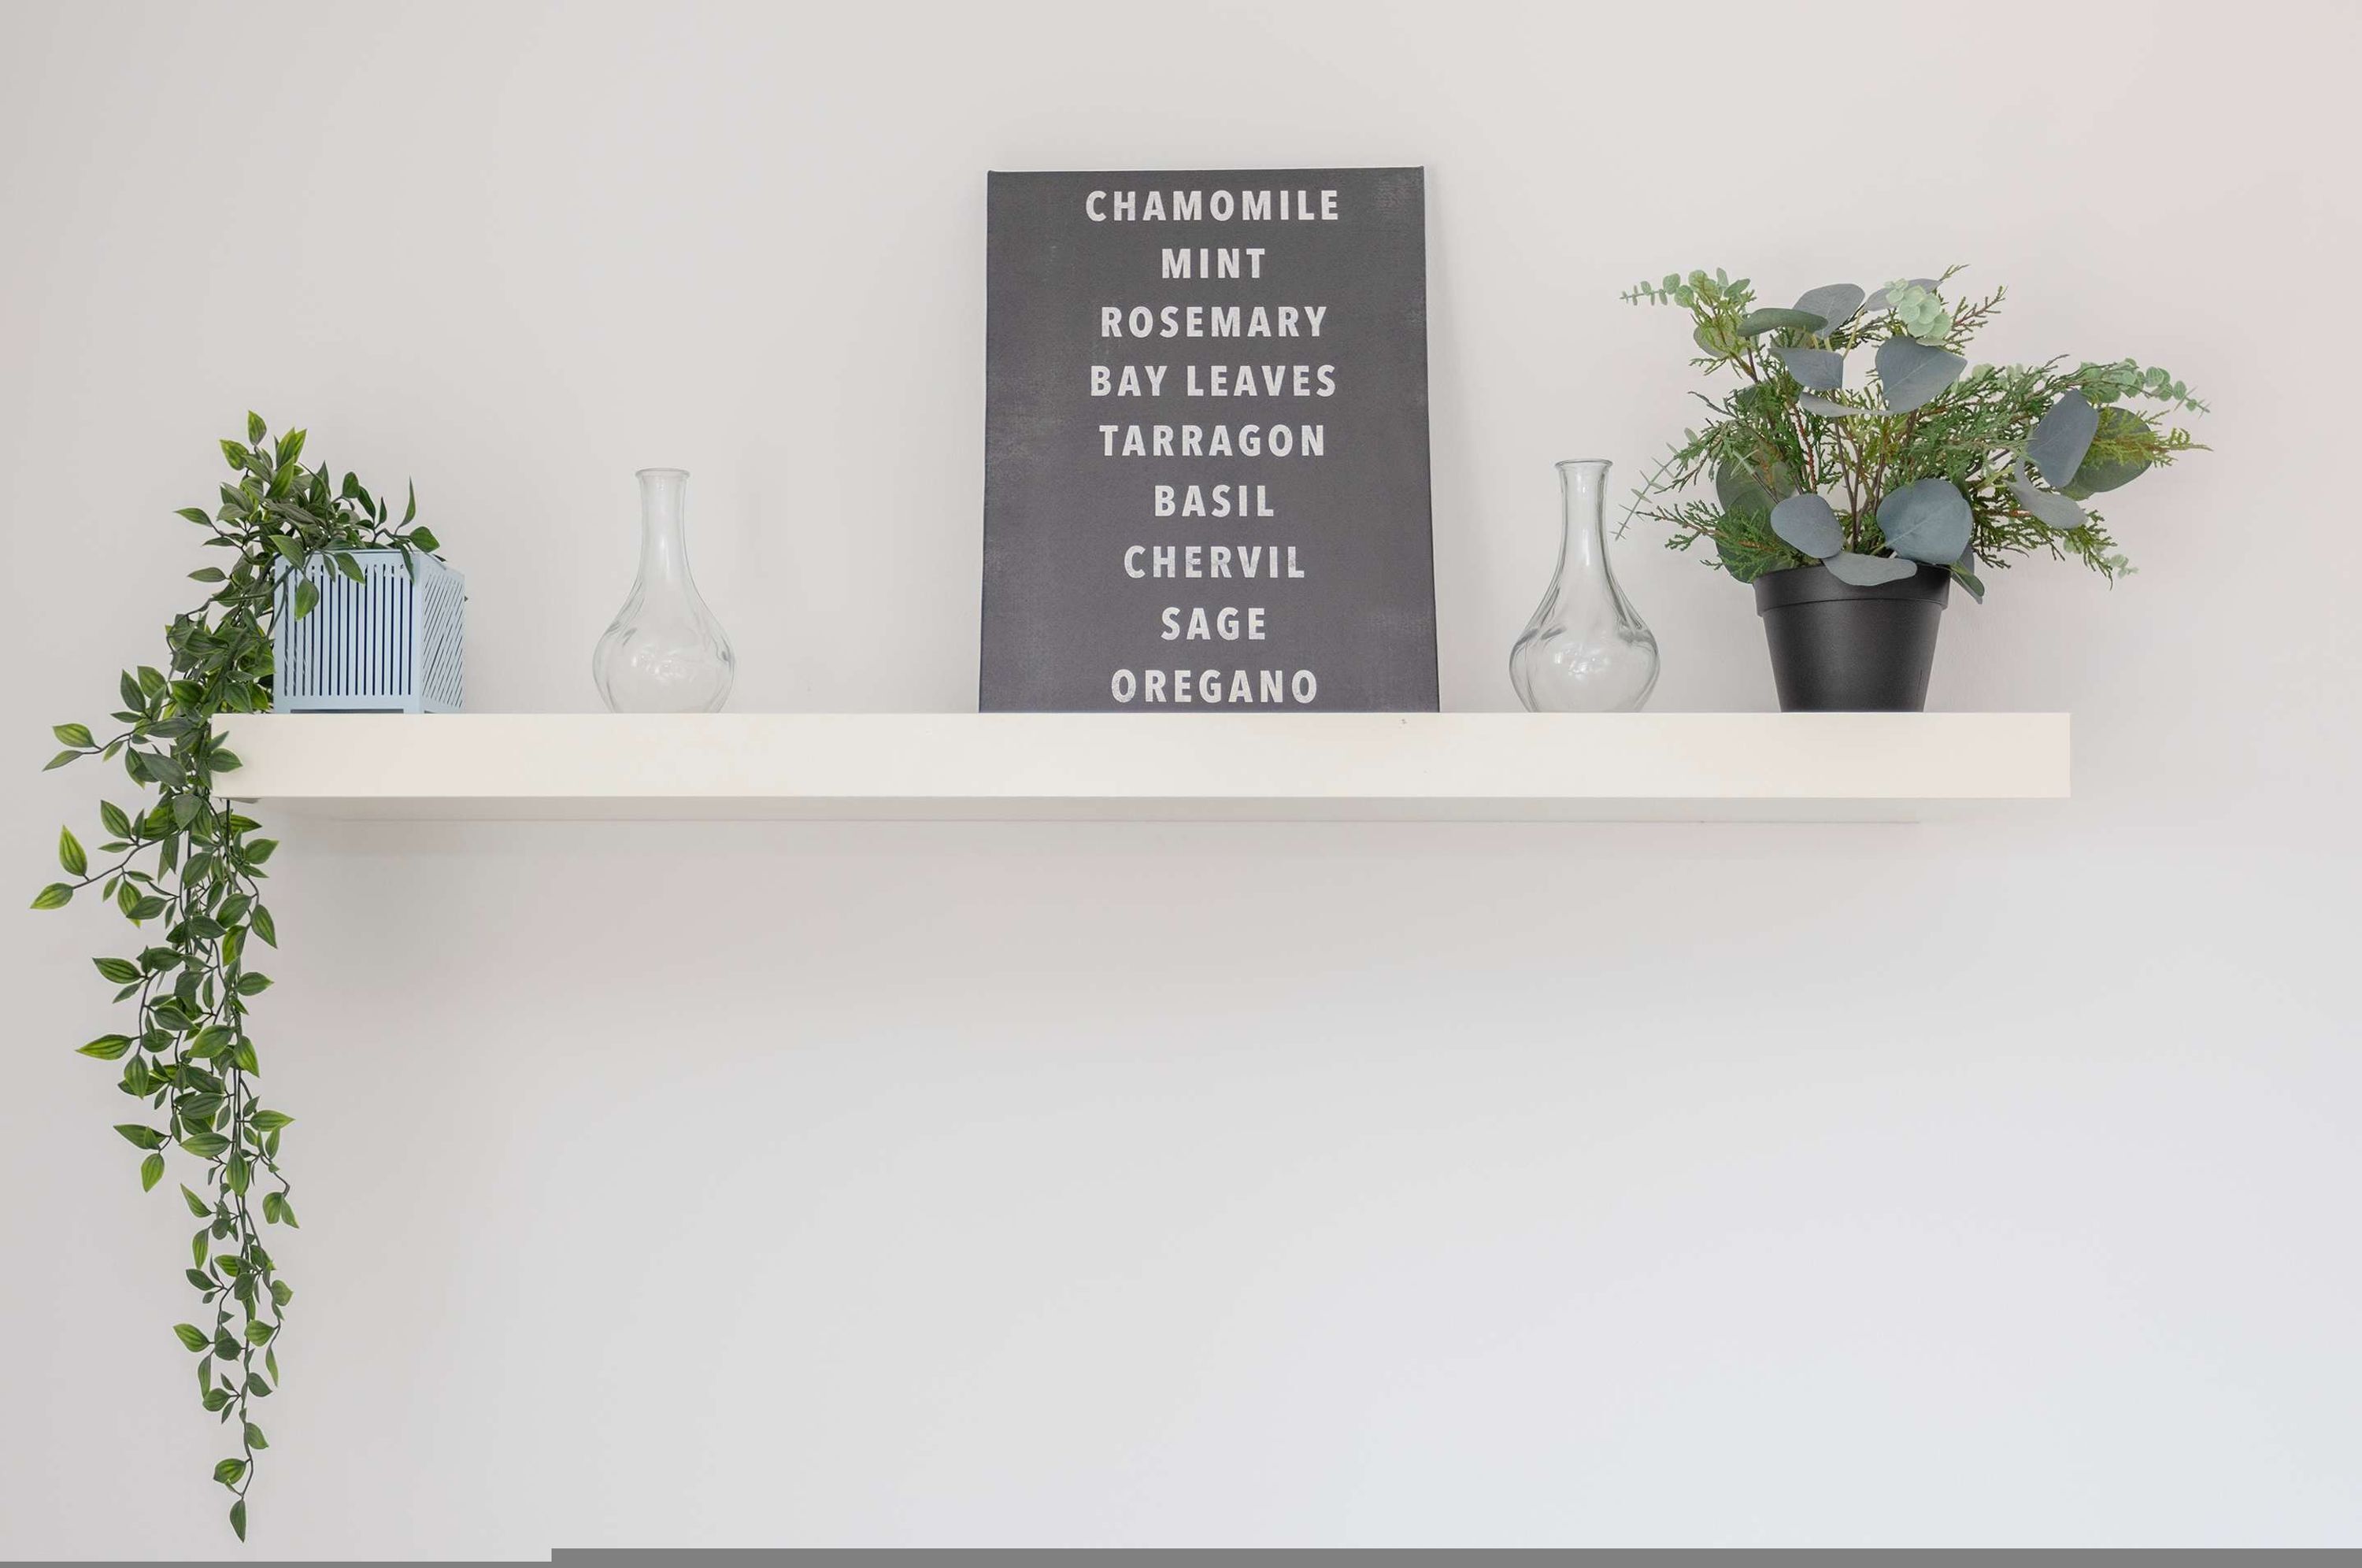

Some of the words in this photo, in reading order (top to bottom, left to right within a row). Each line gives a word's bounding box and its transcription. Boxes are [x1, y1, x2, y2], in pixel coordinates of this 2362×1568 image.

[1086, 190, 1338, 222] CHAMOMILE
[1161, 248, 1265, 279] MINT
[1101, 305, 1327, 338] ROSEMARY
[1090, 364, 1168, 398] BAY
[1187, 364, 1337, 398] LEAVES
[1099, 423, 1324, 457] TARRAGON
[1154, 484, 1274, 518] BASIL
[1124, 545, 1305, 579] CHERVIL
[1161, 606, 1266, 641] SAGE
[1111, 668, 1317, 704] OREGANO
